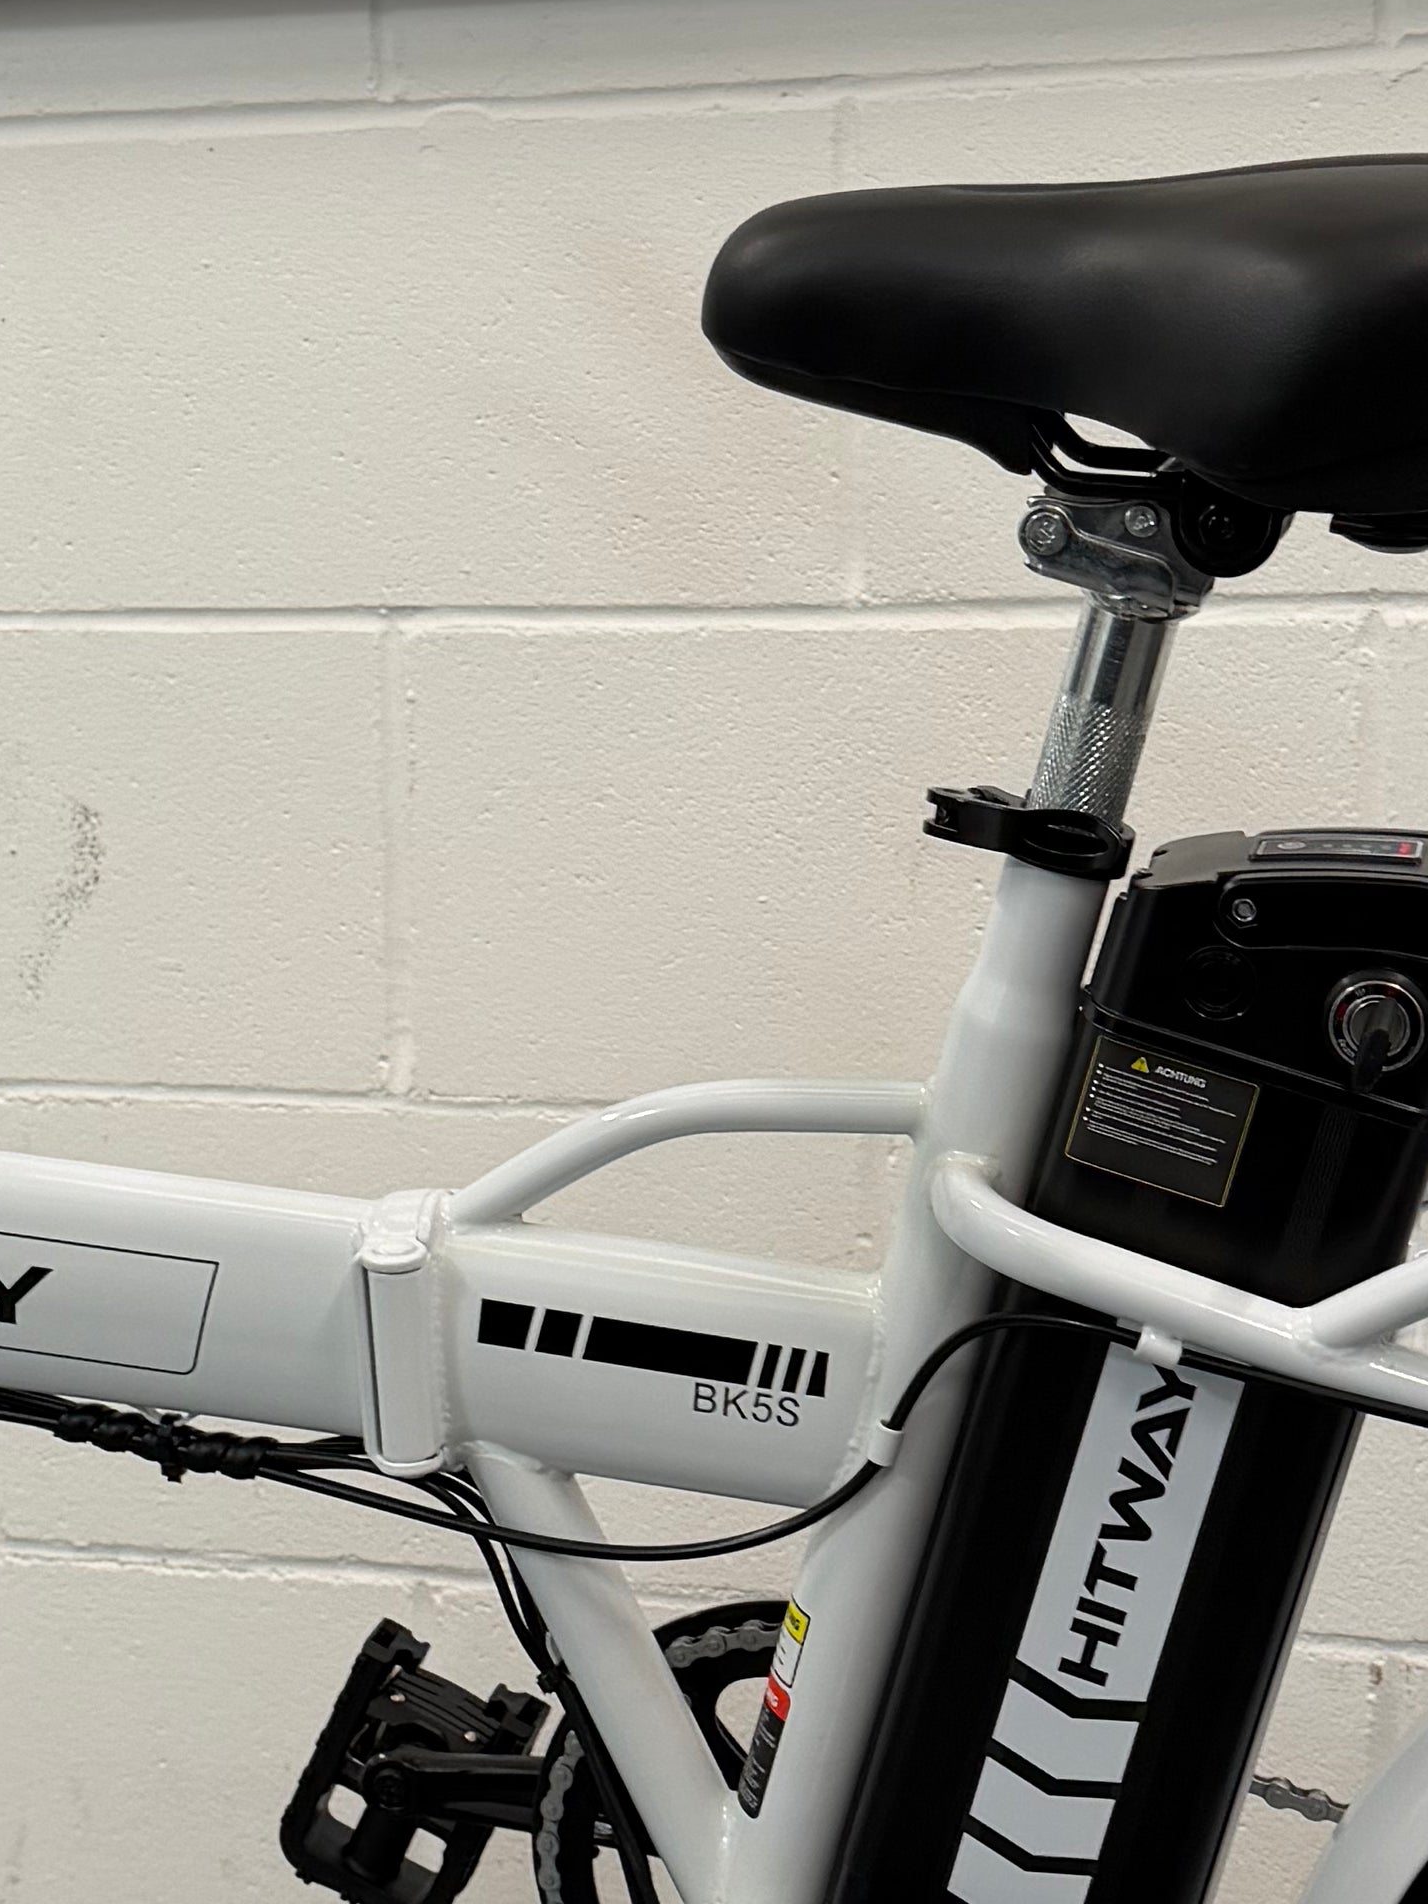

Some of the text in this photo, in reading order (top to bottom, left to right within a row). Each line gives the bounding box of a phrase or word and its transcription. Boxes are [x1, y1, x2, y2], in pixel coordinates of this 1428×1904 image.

[1155, 1065, 1207, 1089] ACHTUNG
[693, 1382, 801, 1427] BK5S
[1058, 1364, 1197, 1687] HITWAY
